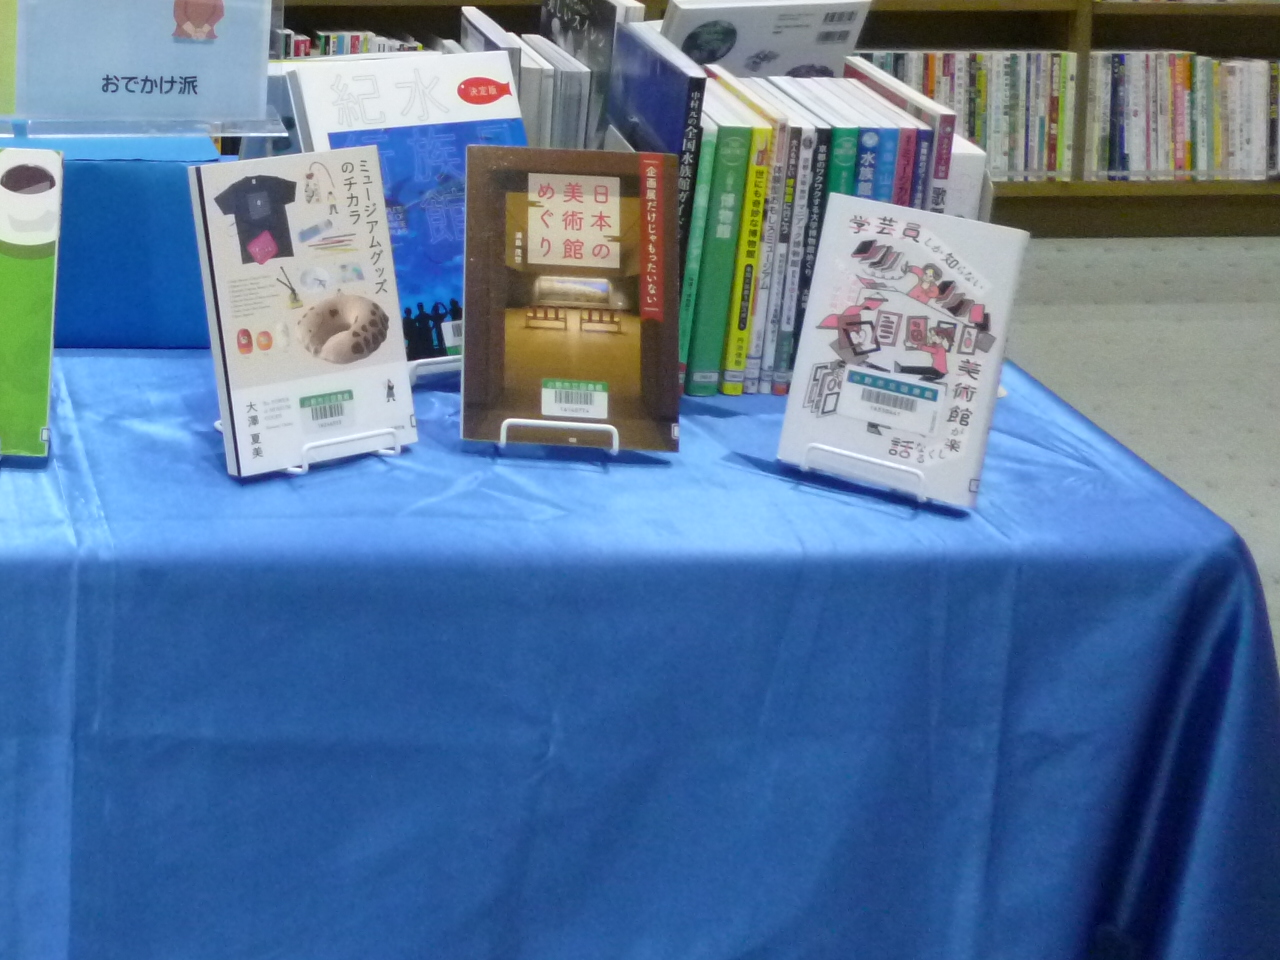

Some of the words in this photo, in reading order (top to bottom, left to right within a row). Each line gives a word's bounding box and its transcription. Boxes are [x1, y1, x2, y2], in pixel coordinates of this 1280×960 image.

[101, 74, 198, 95] おでかけ派
[341, 161, 362, 225] のチカラ
[360, 159, 388, 295] ミュージアムグッズ
[537, 183, 556, 258] めぐり
[562, 182, 585, 260] 美術館
[590, 185, 612, 260] 日本の
[644, 165, 658, 304] 企画展だけじゃもったいない
